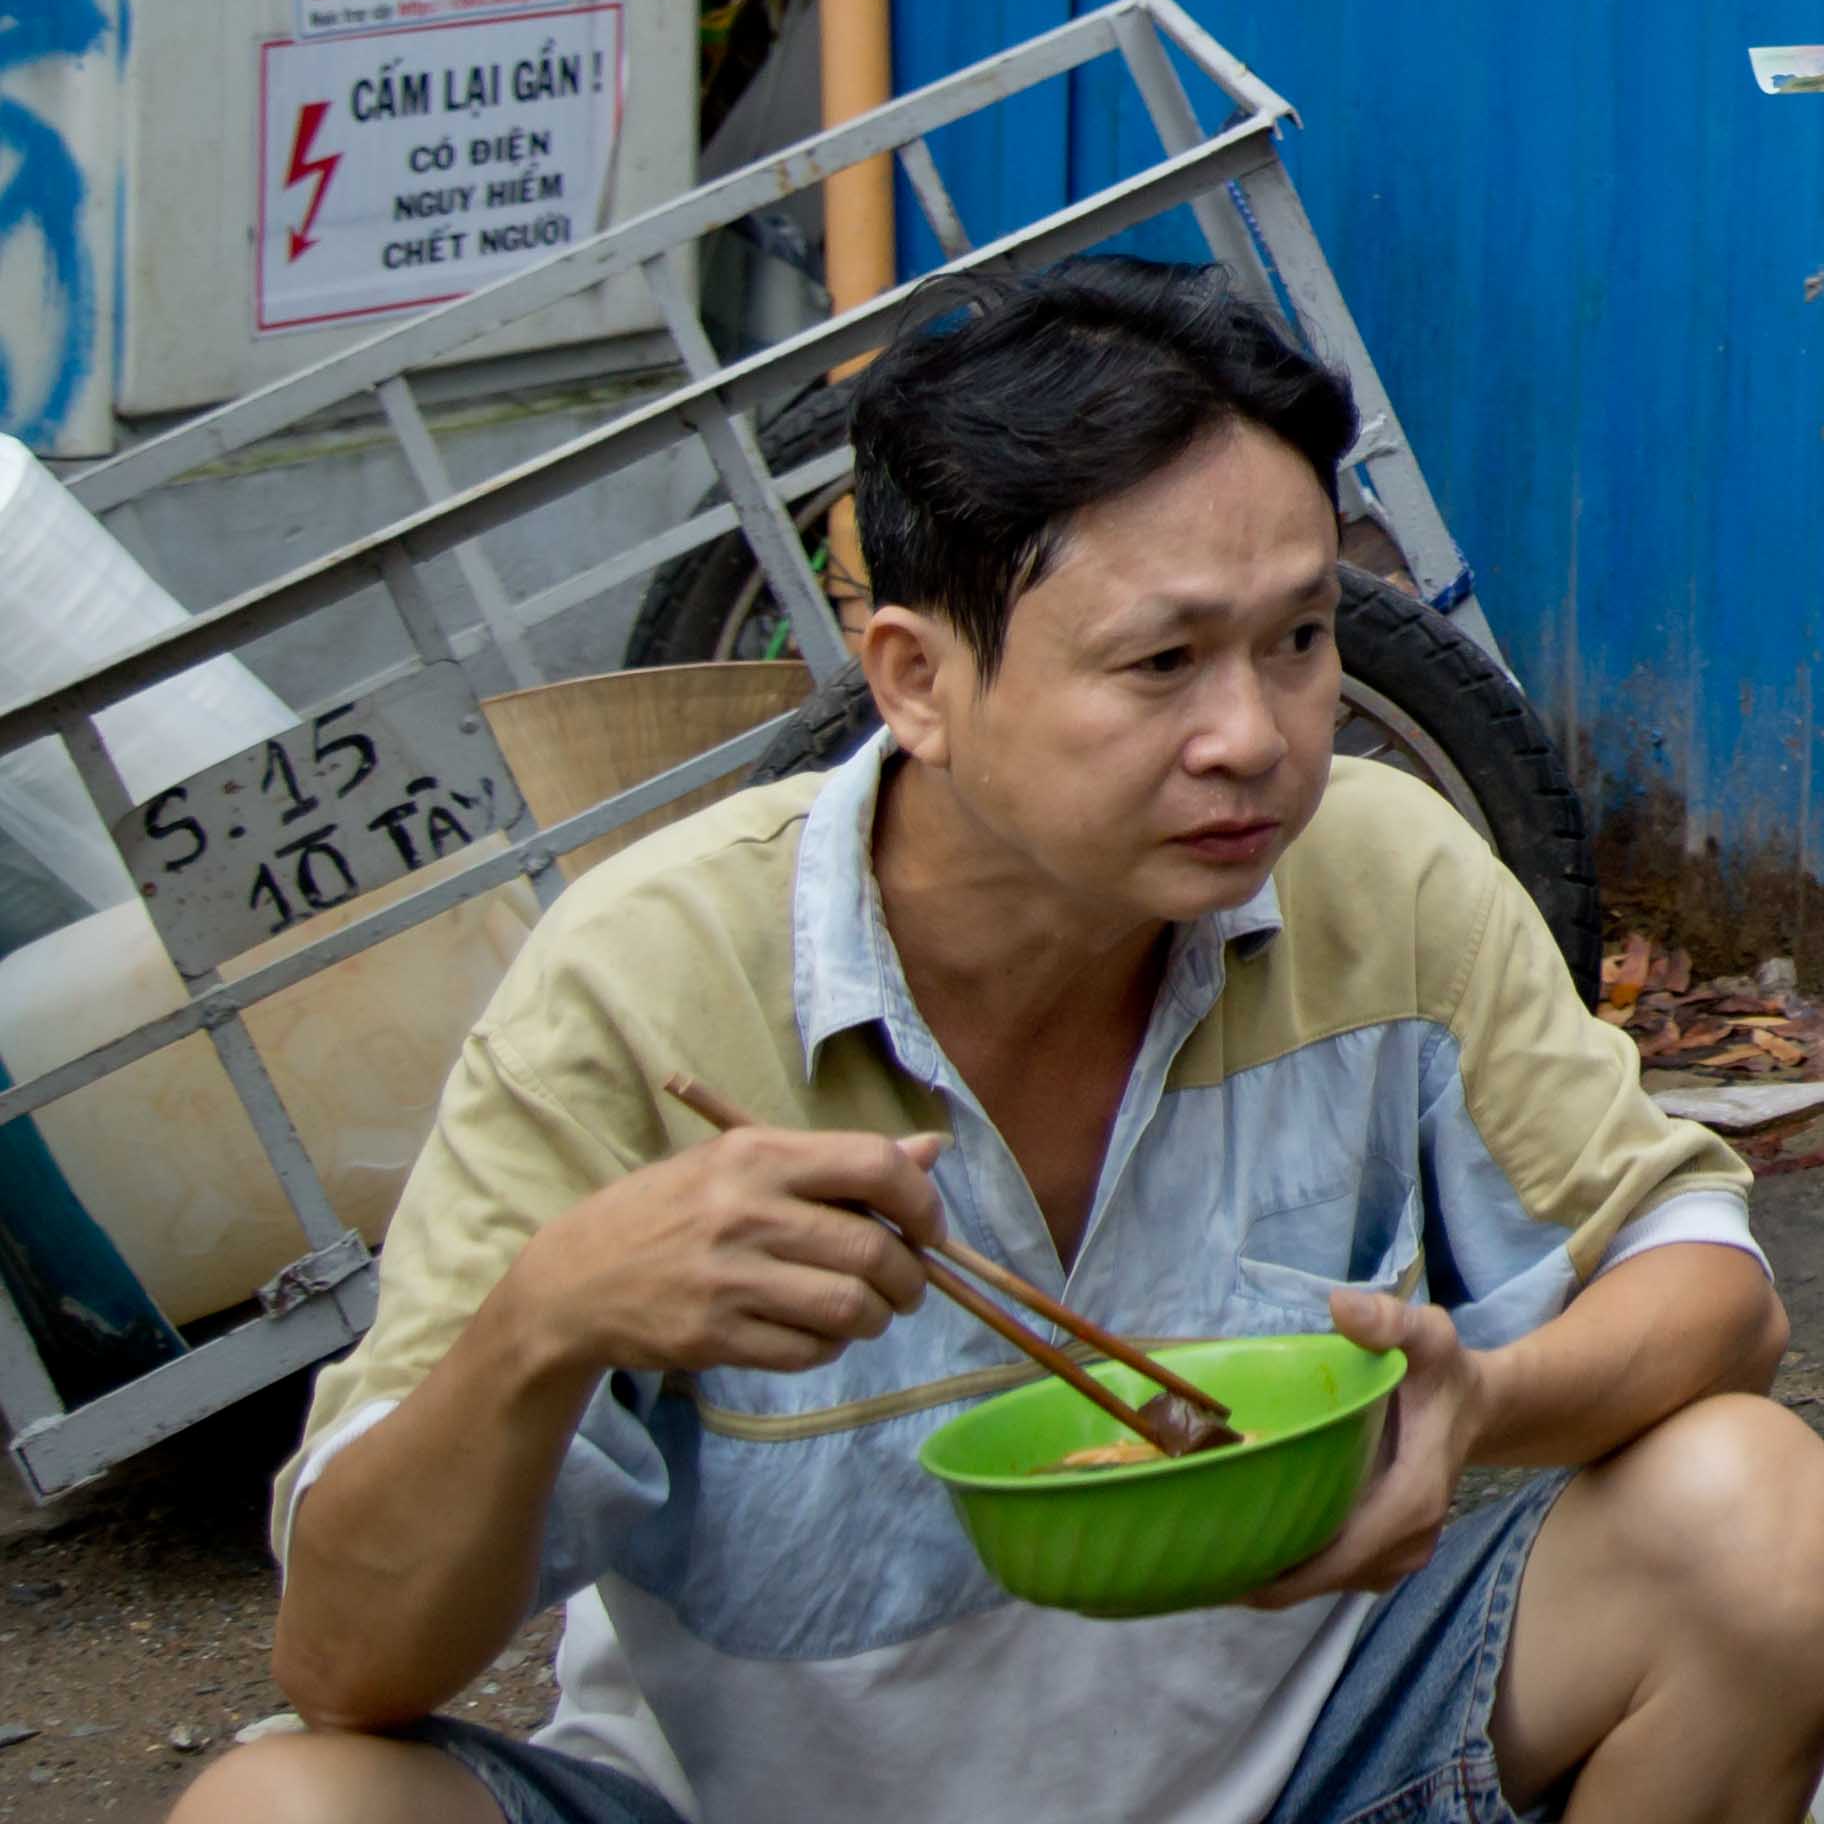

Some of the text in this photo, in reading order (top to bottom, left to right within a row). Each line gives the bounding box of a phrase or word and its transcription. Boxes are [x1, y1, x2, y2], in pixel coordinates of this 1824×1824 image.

[352, 57, 431, 122] CẤM
[444, 64, 500, 118] LẠI
[409, 126, 550, 173] CÓ ĐIỆN
[394, 185, 474, 221] NGUY
[383, 224, 467, 269] CHẾT
